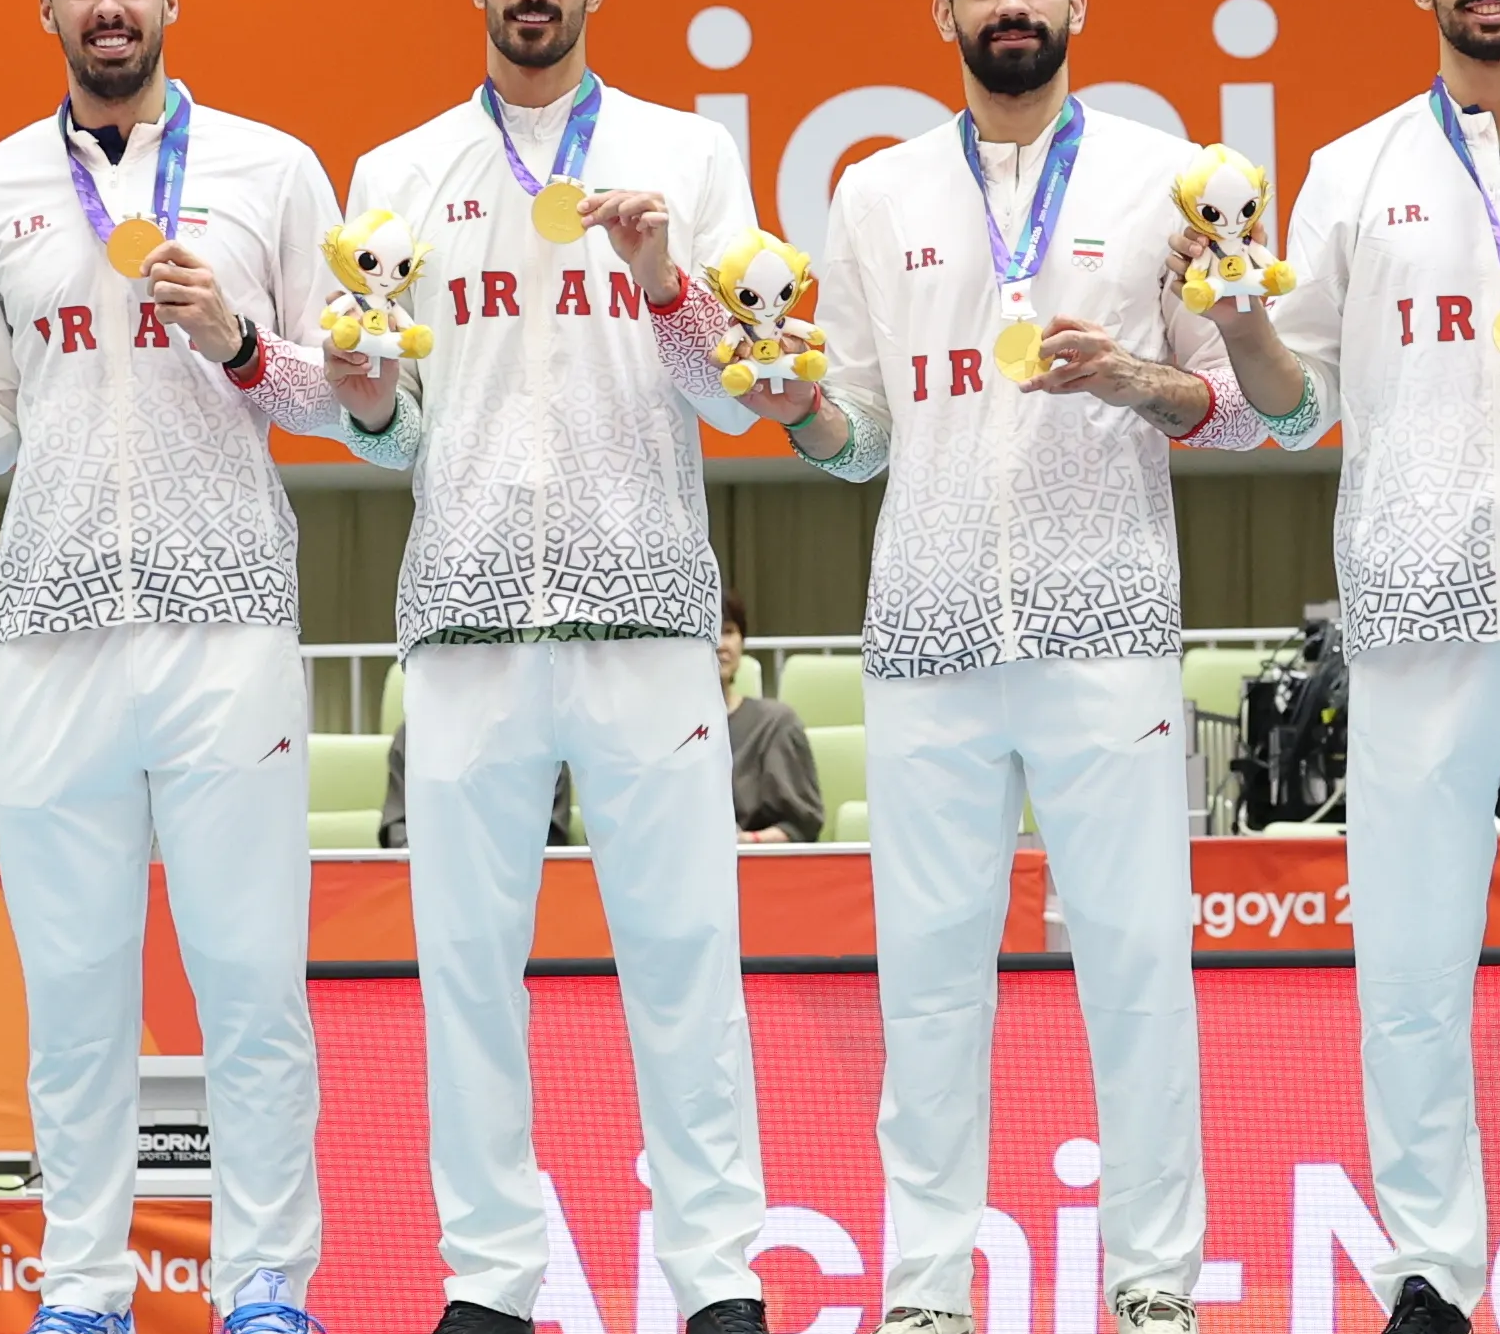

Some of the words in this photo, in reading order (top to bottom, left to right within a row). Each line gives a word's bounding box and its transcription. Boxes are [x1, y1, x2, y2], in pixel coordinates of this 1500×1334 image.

[446, 200, 487, 223] I.R.
[1387, 204, 1429, 226] I.R.
[13, 215, 51, 239] I.R.
[905, 247, 944, 271] I.R.
[448, 270, 642, 325] IRAN
[911, 348, 984, 403] IR
[173, 1152, 211, 1161] TECHNO
